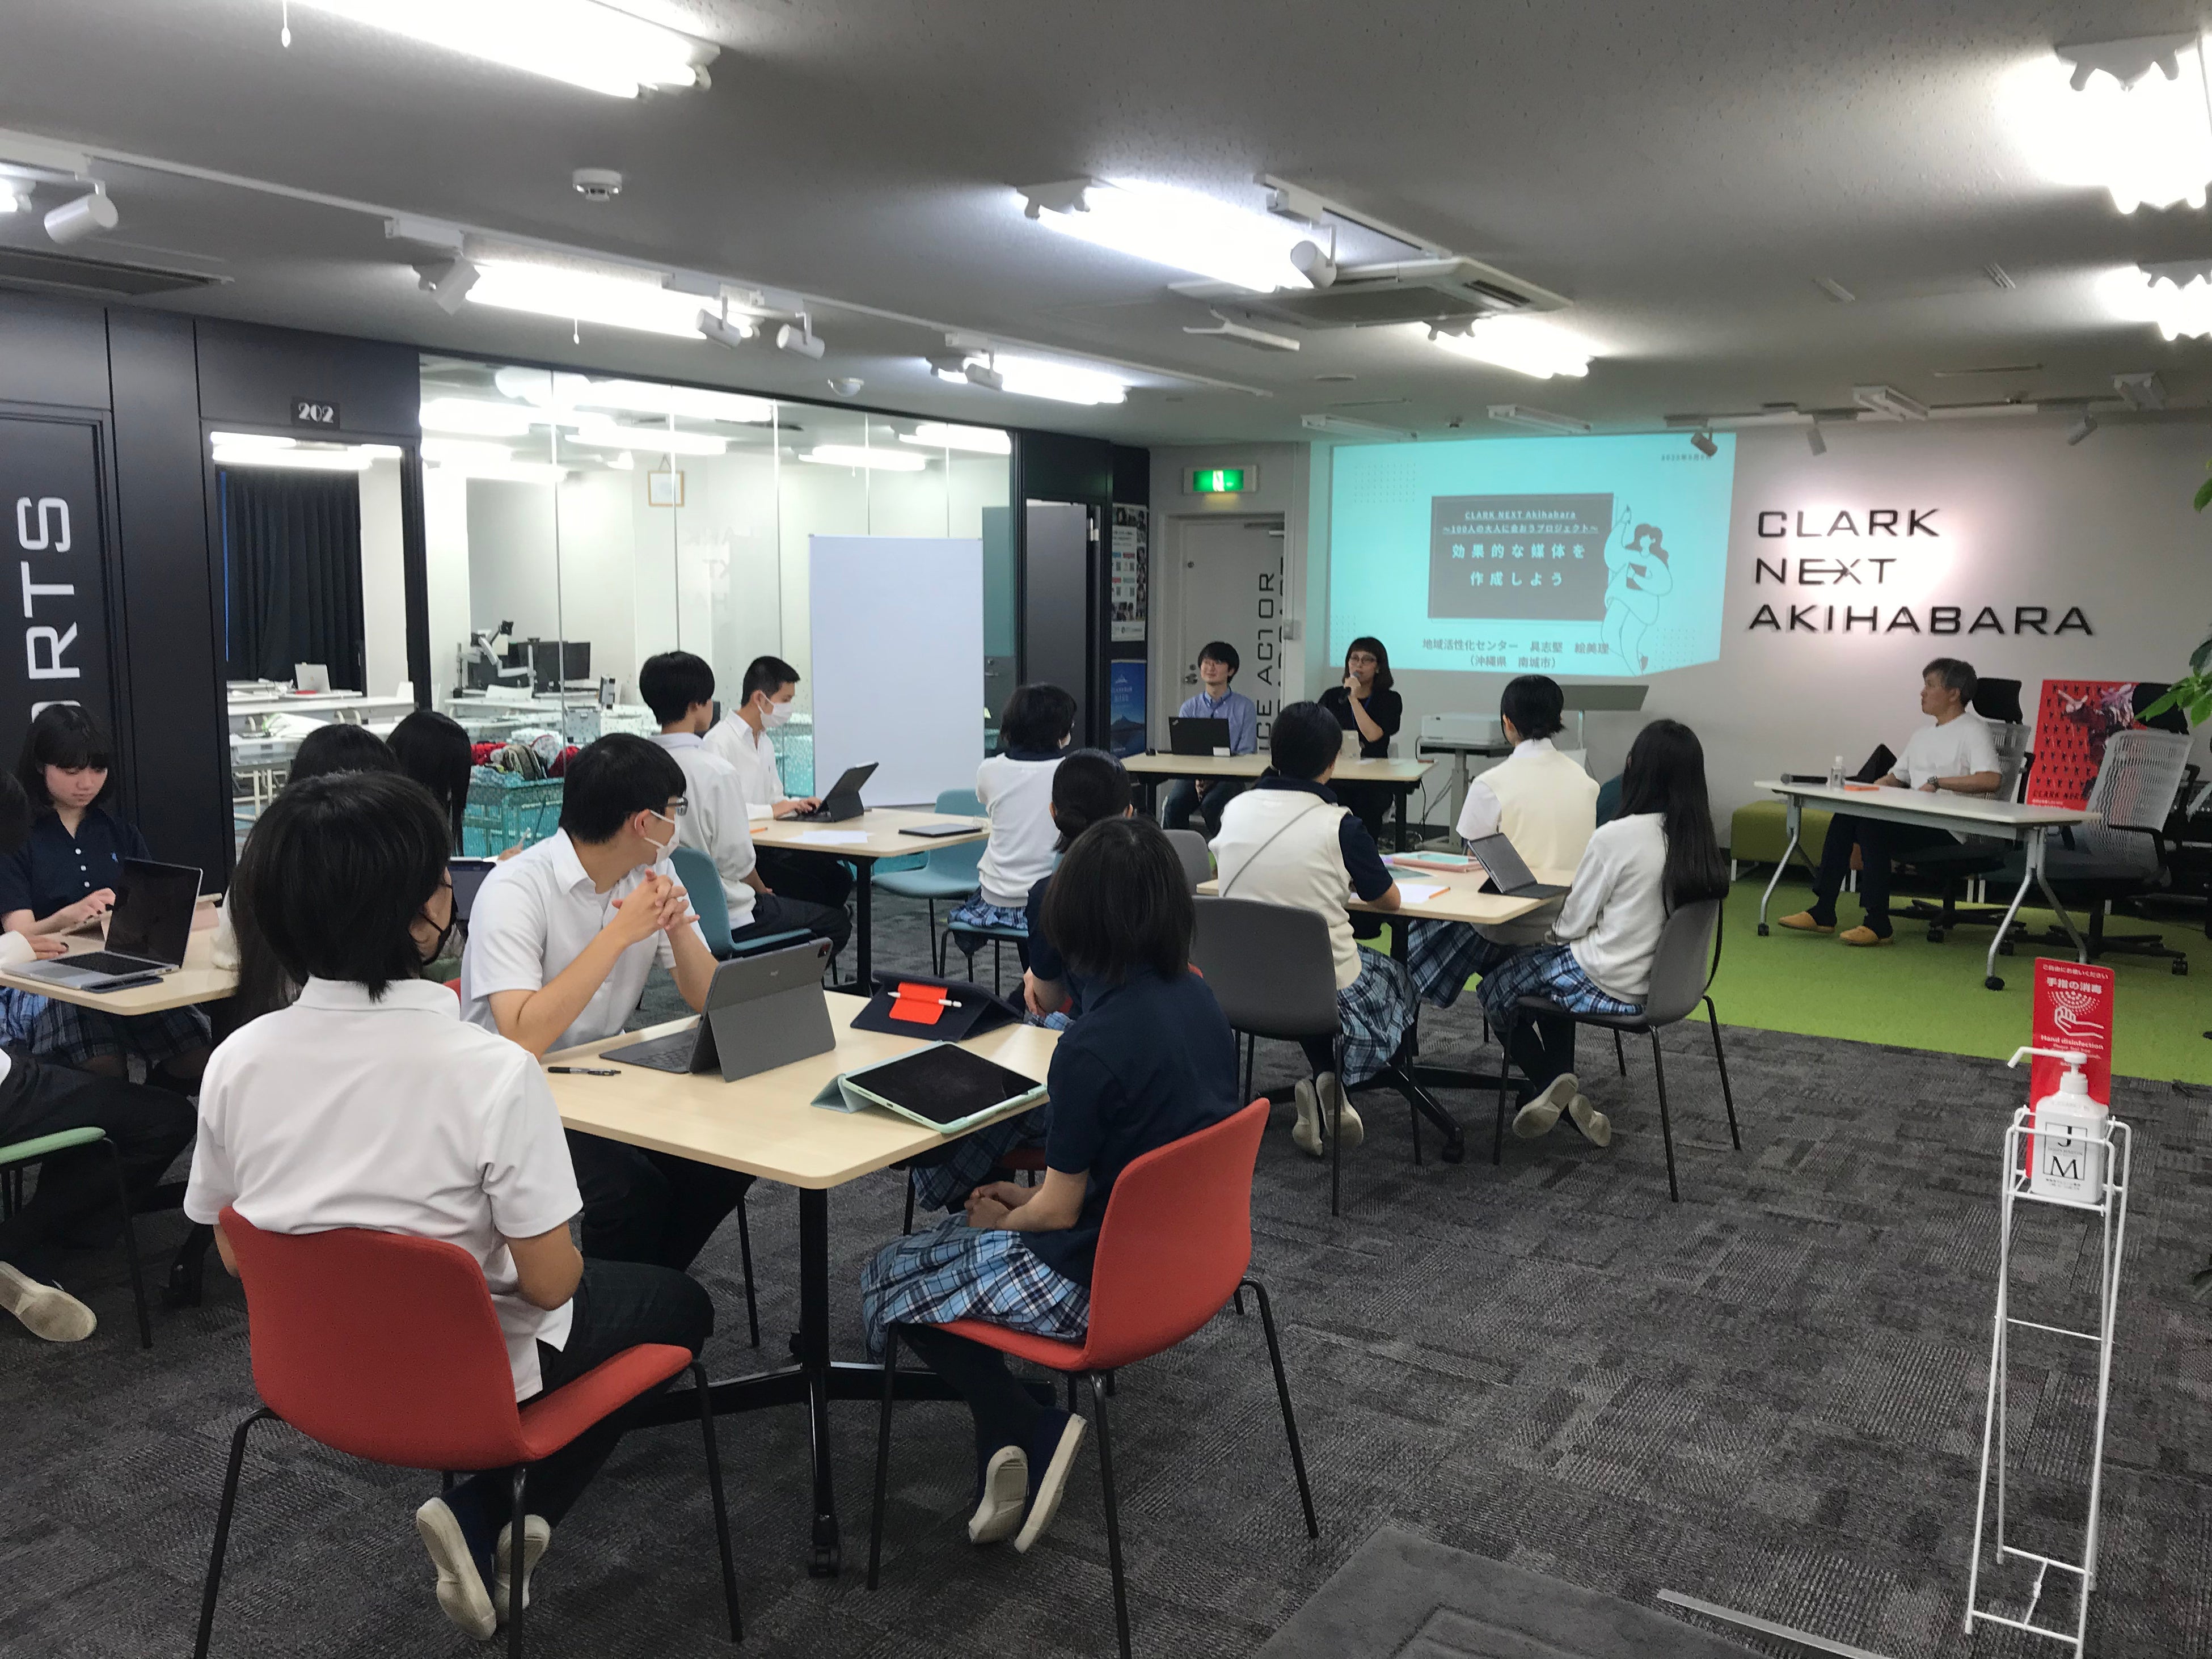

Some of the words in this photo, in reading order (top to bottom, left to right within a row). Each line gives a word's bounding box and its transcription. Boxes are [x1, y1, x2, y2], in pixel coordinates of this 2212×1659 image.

[298, 402, 334, 423] 202
[1465, 511, 1495, 520] CLARK
[1498, 510, 1522, 520] NEXT
[1525, 510, 1576, 520] Akihabara
[1758, 508, 1939, 538] CLARK
[1470, 571, 1562, 586] 作成しよう
[1755, 558, 1897, 585] NEXT
[16, 496, 81, 723] RTS
[1748, 604, 2094, 635] AKIHABARA
[1422, 639, 1518, 651] 地域活性化センター
[2046, 977, 2102, 994] 手指の消毒
[2041, 1035, 2060, 1044] Hand
[2061, 1038, 2104, 1050] disinfection
[2057, 1126, 2072, 1147] J
[2051, 1155, 2079, 1179] M
